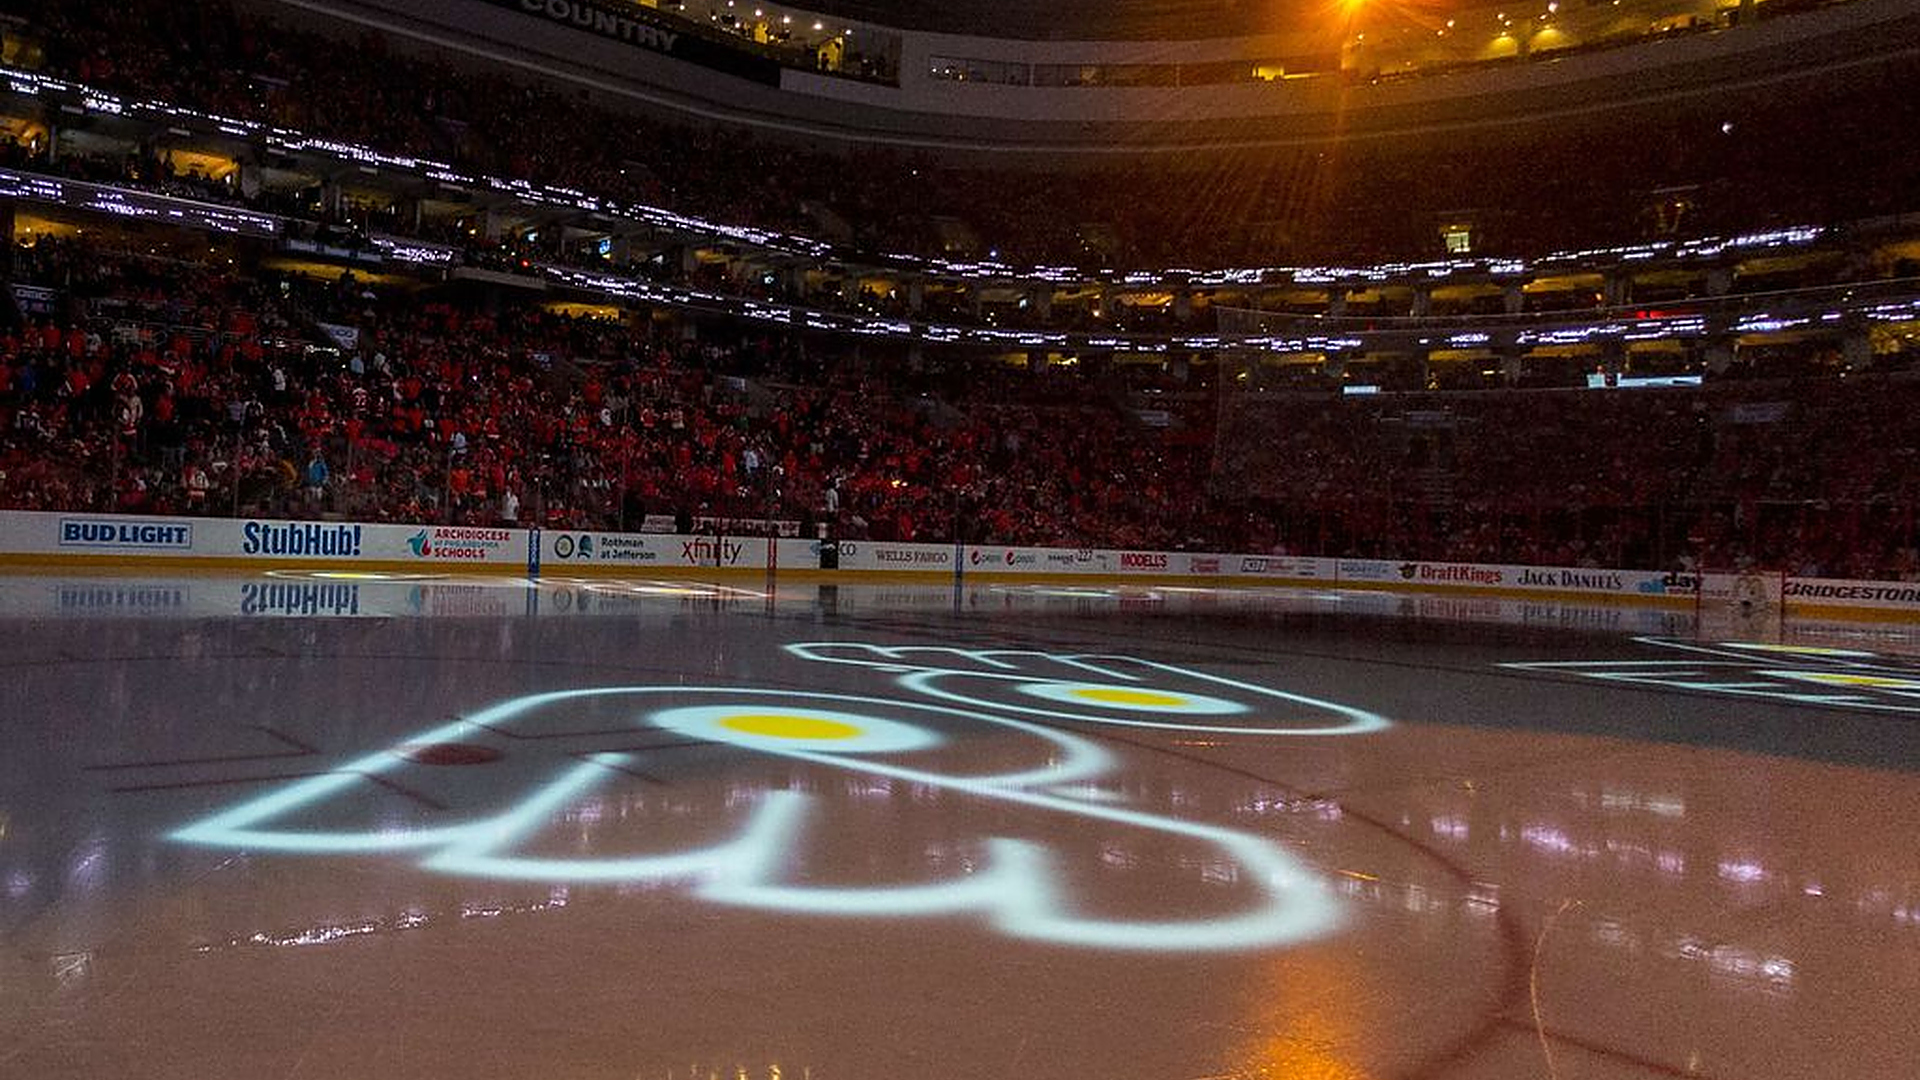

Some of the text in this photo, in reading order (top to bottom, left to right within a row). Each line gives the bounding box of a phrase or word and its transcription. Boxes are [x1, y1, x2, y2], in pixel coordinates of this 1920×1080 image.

[64, 523, 187, 543] BUD LIGHT
[243, 521, 361, 551] StubHub!
[434, 528, 510, 541] ARCHDIOCESE
[600, 537, 644, 548] Rothman
[434, 547, 485, 558] SCHOOLS
[600, 549, 656, 559] at Jefferson
[876, 550, 912, 563] WELLS
[1421, 565, 1502, 584] DraftKings
